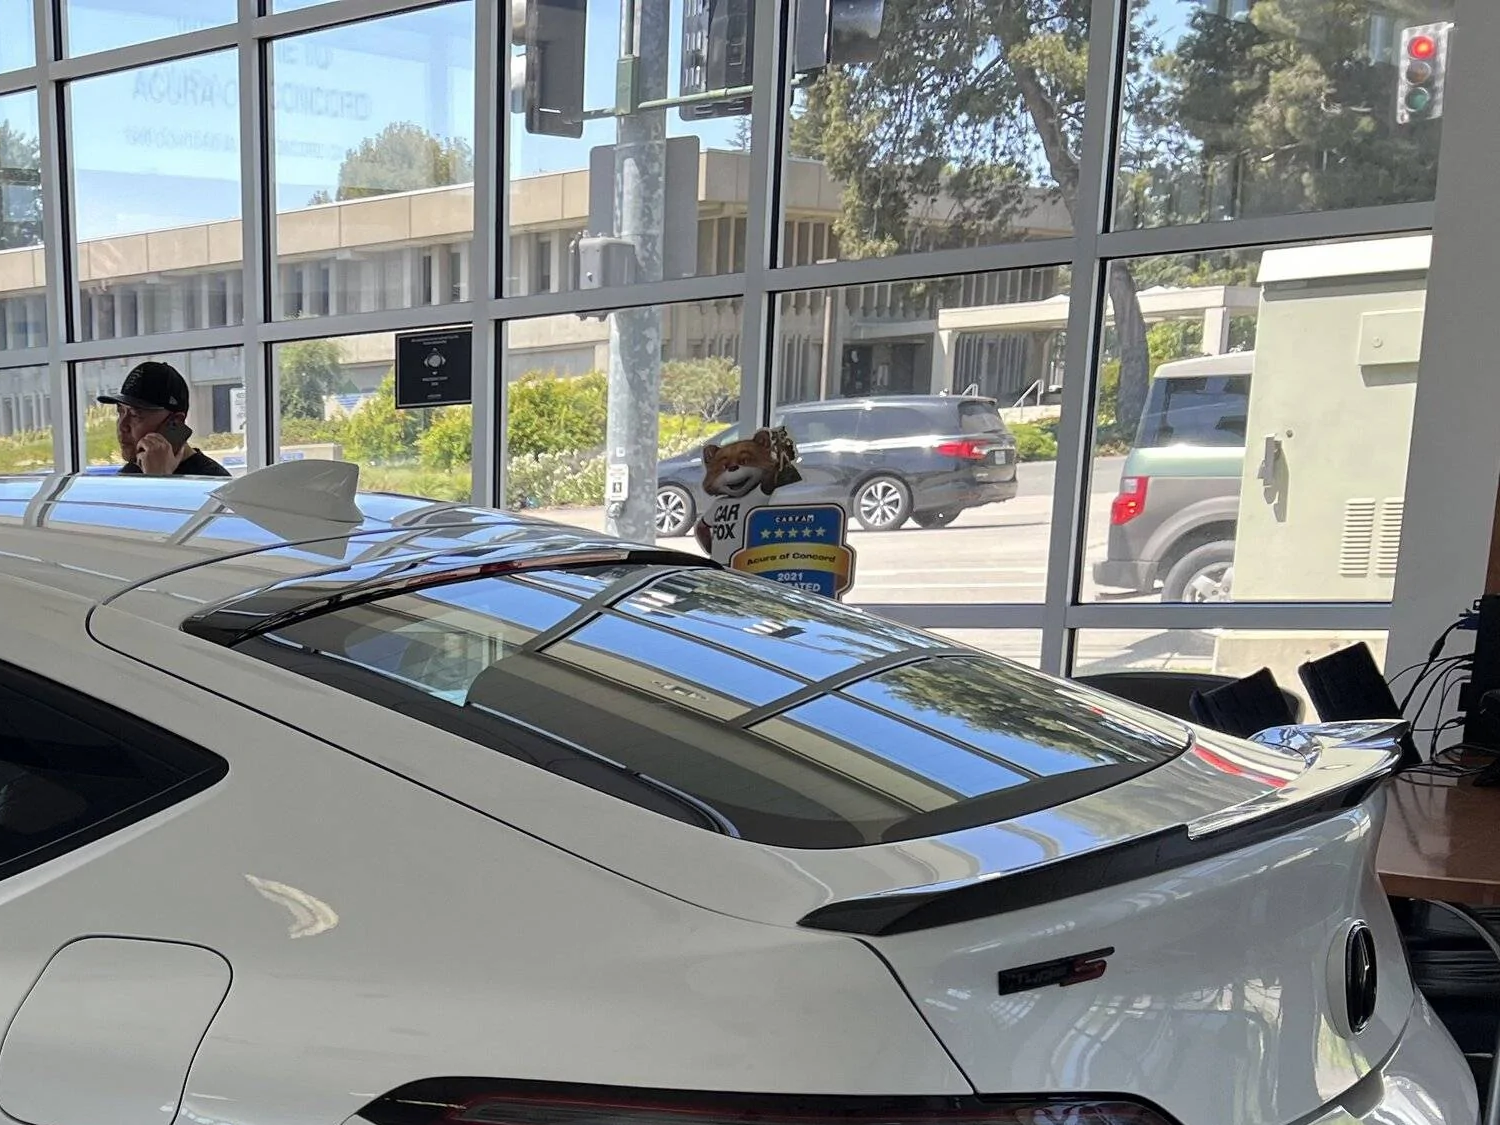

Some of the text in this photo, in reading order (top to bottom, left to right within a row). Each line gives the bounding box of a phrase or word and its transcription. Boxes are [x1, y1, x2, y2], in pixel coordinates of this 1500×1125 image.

[713, 503, 741, 522] CAR
[711, 523, 736, 540] FOX
[747, 551, 837, 566] Acura of Concord
[776, 571, 804, 582] 2021
